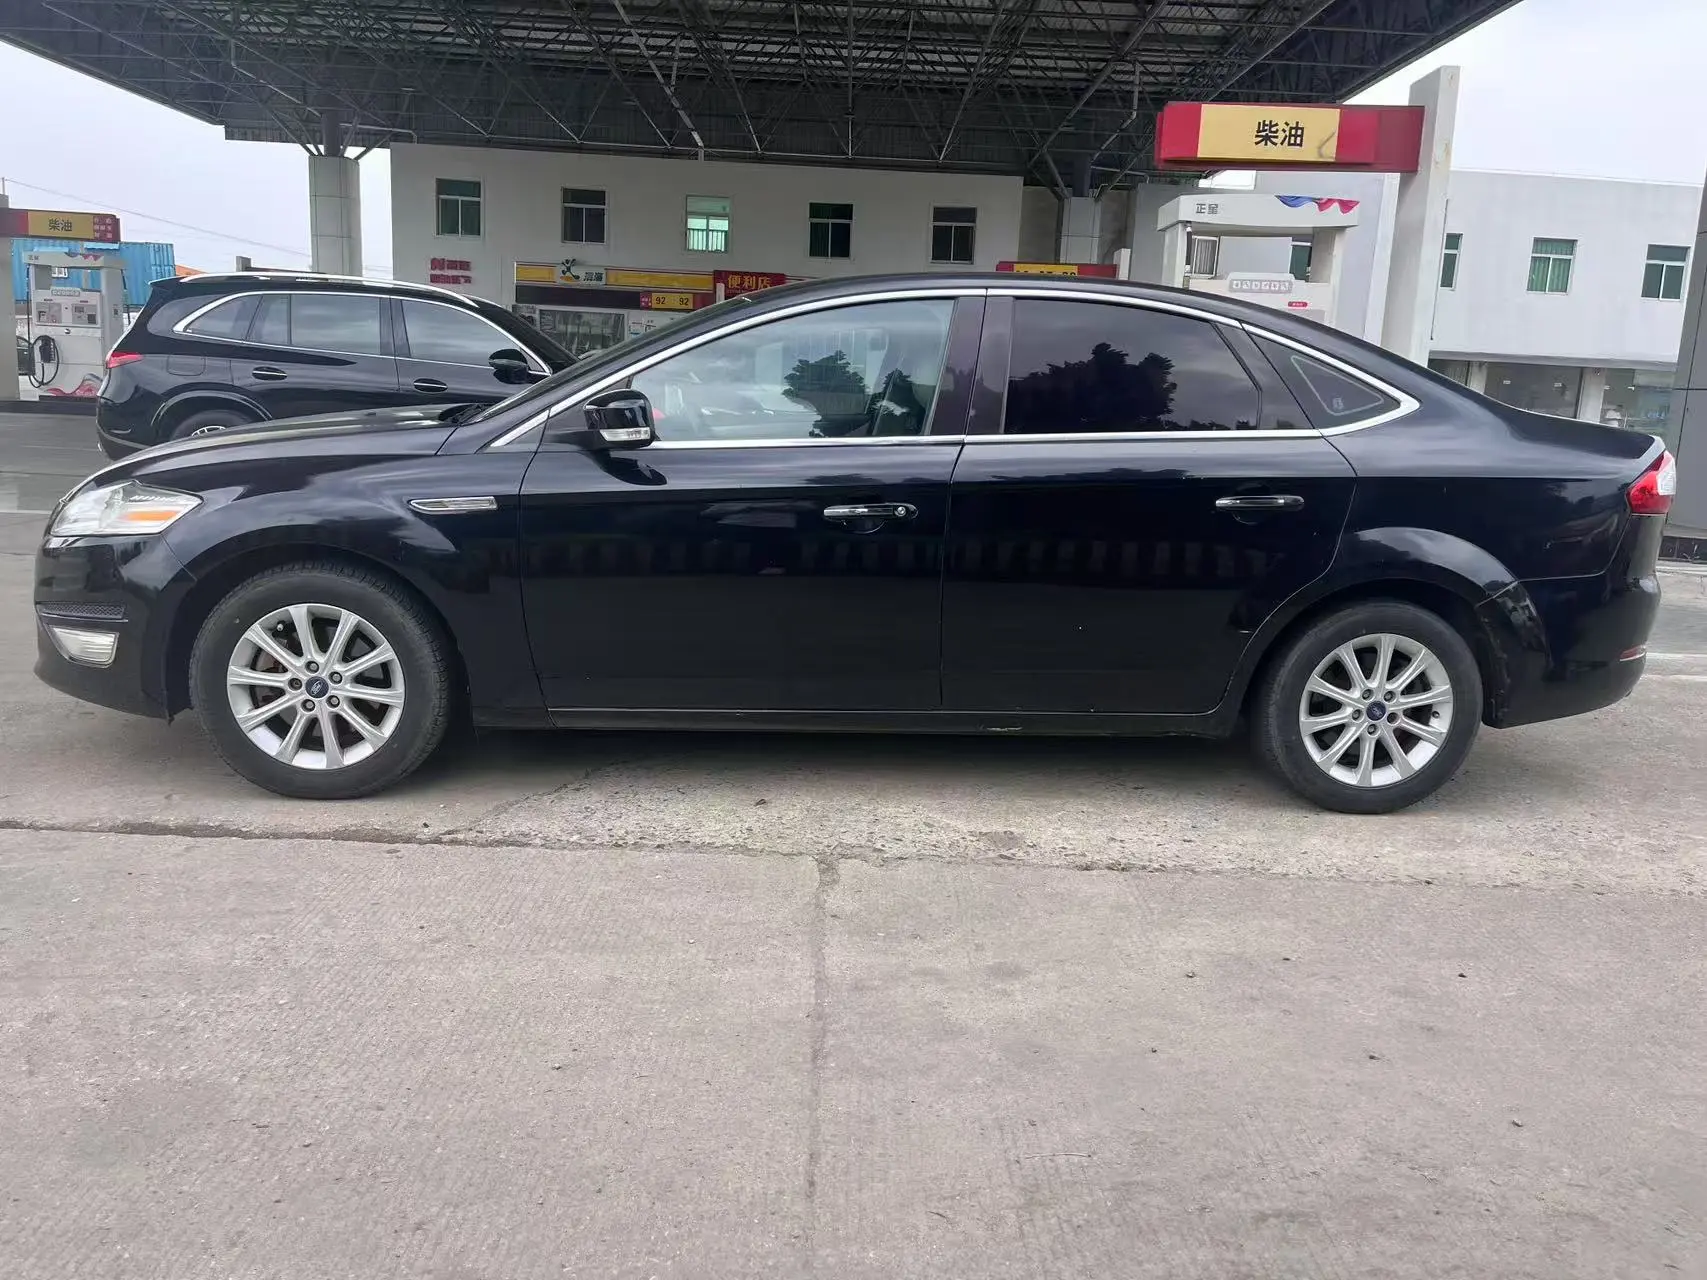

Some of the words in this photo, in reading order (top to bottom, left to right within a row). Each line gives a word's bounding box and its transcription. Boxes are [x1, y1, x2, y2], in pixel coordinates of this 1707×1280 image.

[1254, 120, 1305, 148] 柴油
[48, 217, 73, 232] 柴油
[728, 274, 772, 290] 便利店
[655, 296, 666, 305] 92
[679, 297, 689, 306] 92
